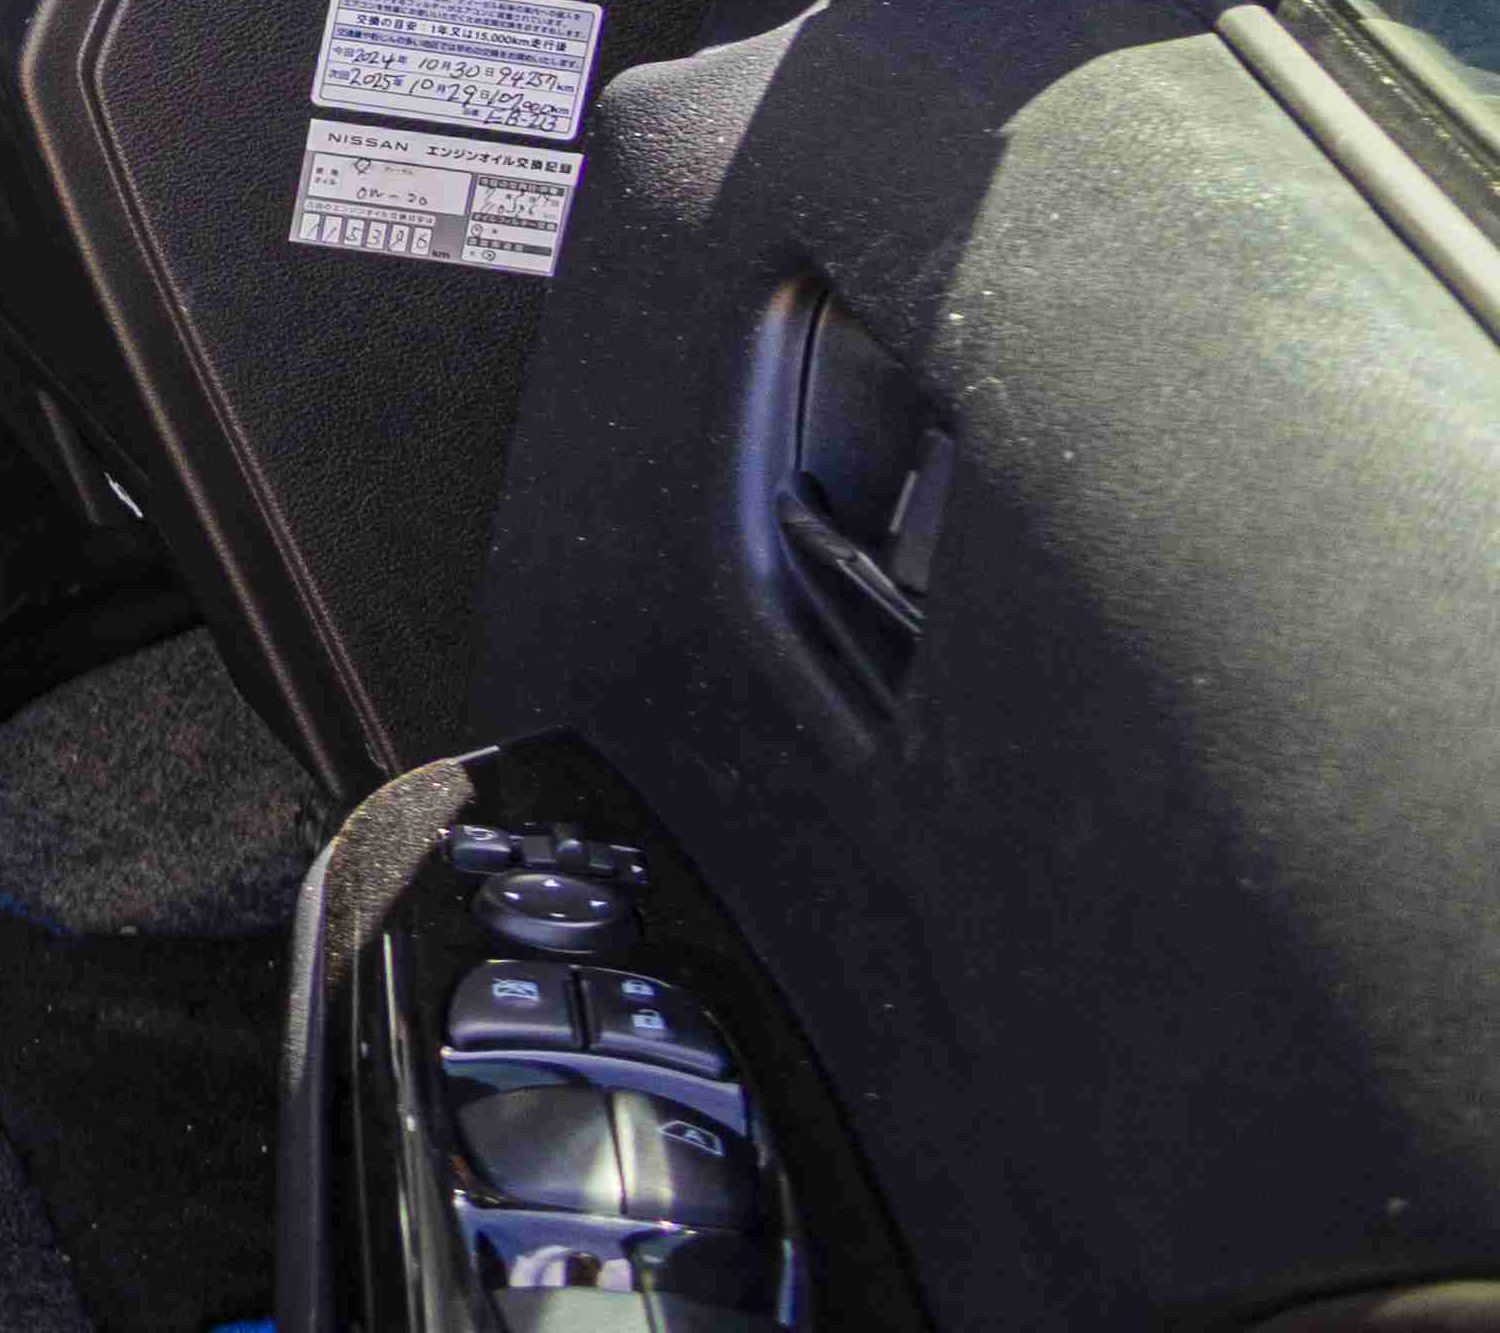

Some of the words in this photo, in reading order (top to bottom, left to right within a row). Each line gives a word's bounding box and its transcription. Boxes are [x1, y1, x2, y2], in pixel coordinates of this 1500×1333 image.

[327, 132, 409, 153] NISSAN
[427, 145, 573, 175] エンジンオイル交換記録
